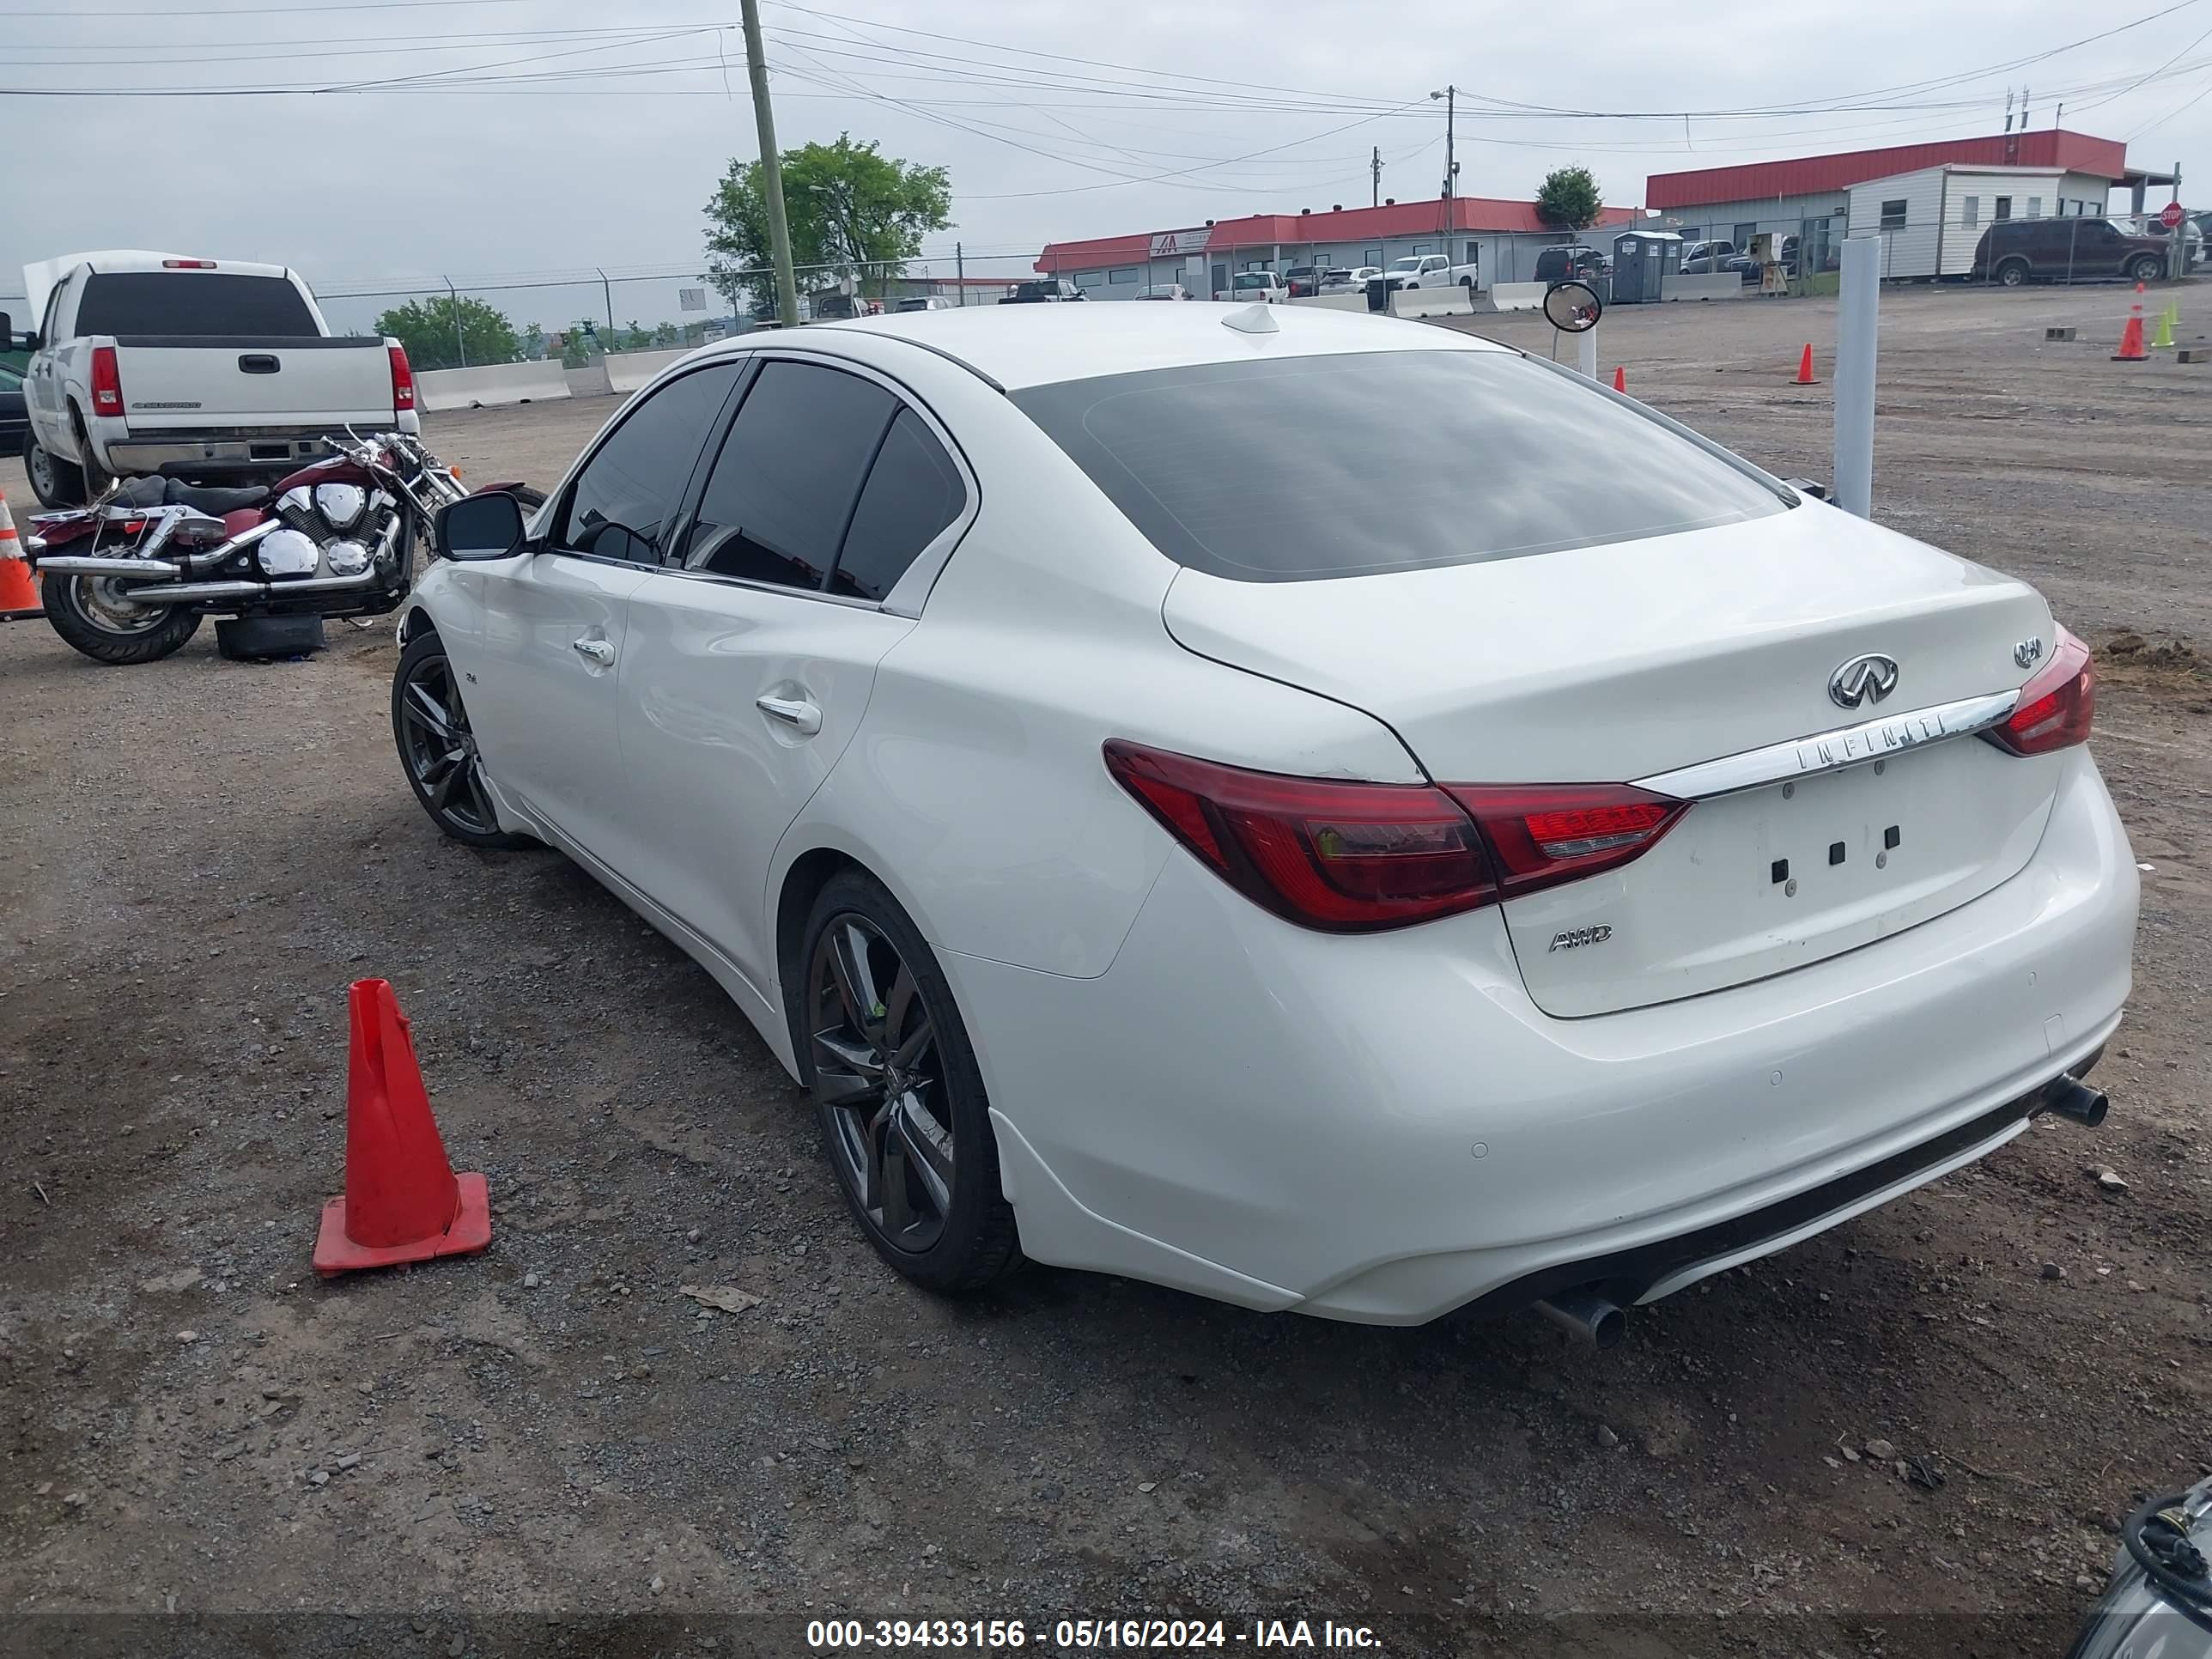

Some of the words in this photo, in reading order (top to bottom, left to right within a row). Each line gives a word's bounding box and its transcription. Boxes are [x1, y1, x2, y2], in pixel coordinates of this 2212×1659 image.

[2162, 210, 2182, 221] STOP
[2013, 635, 2043, 669] Q50
[1796, 714, 1946, 769] INFINITI
[1548, 923, 1613, 953] AWD
